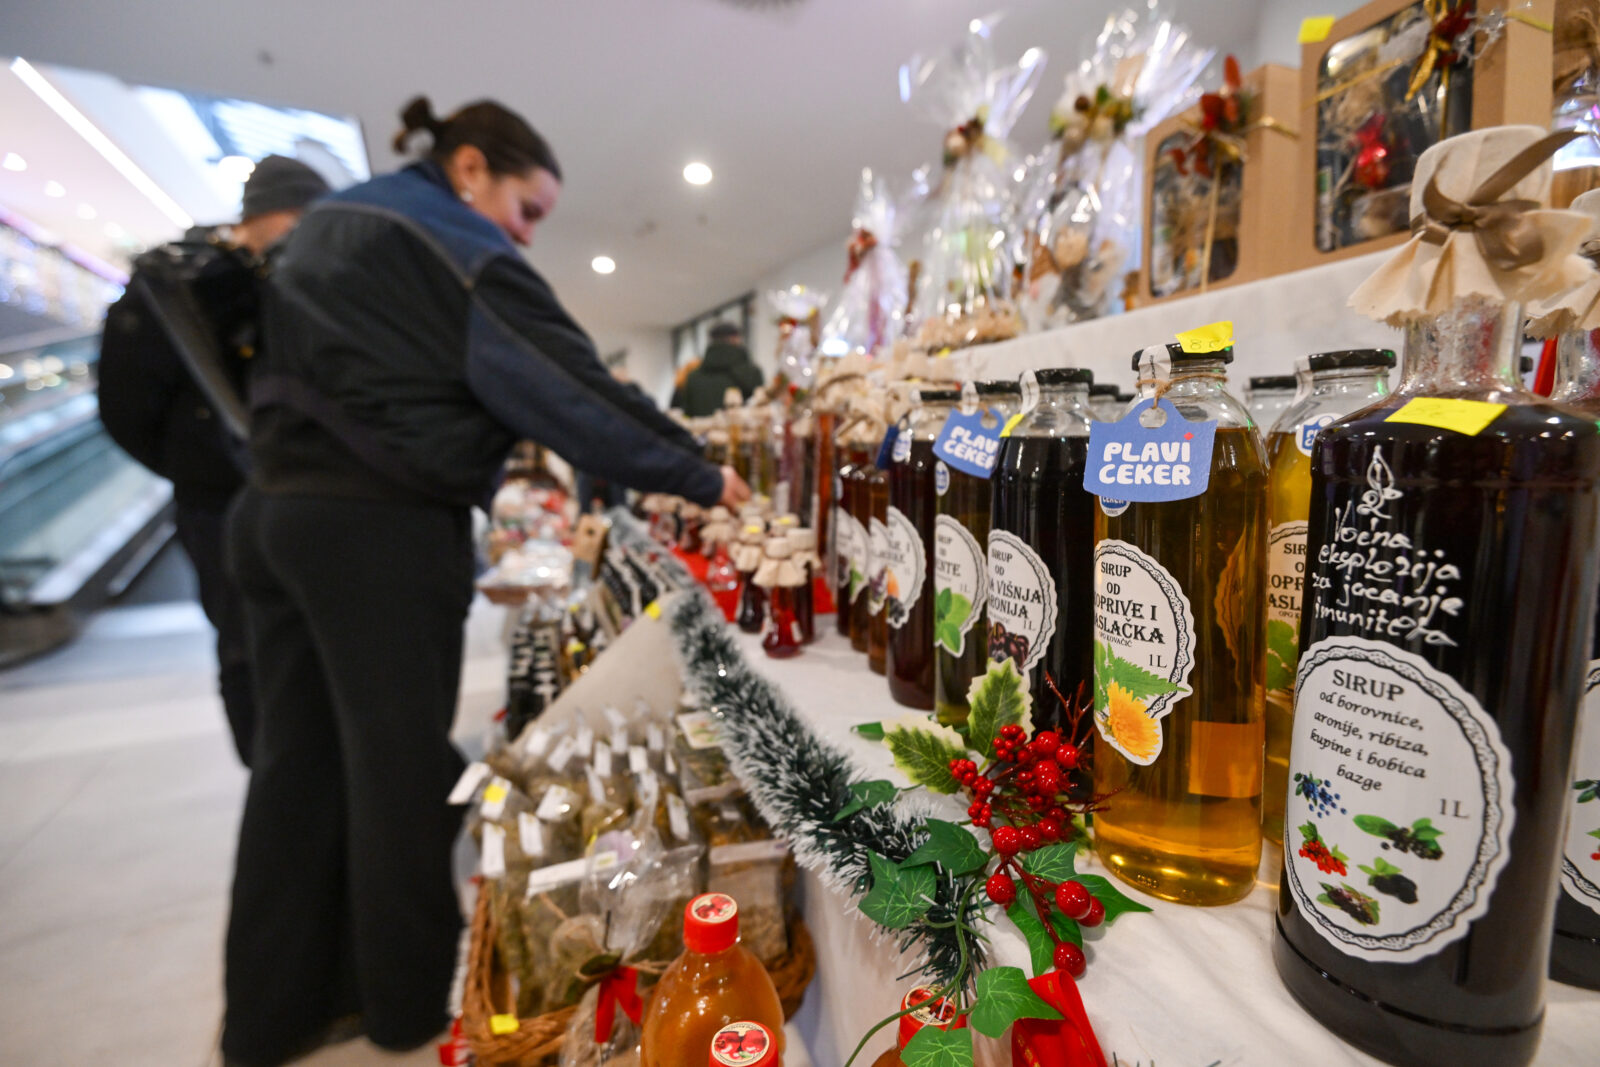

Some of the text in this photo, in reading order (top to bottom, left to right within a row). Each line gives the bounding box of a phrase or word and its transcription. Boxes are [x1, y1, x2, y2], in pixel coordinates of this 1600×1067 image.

[951, 425, 1000, 455] PLAV
[1103, 441, 1191, 463] PLAVI
[1099, 463, 1191, 486] CEKER
[1284, 543, 1307, 556] SIR
[995, 565, 1004, 576] OD
[1100, 561, 1131, 578] SIRUP
[1312, 572, 1331, 588] za
[997, 580, 1042, 604] VIŠNJA
[1106, 581, 1120, 595] OD
[989, 594, 1028, 619] RONIJA
[1094, 592, 1145, 620] OPRIVE
[1094, 612, 1165, 644] ASLAČKA
[1333, 669, 1404, 701] SIRUP
[1320, 692, 1424, 730] od borovnice,
[1314, 712, 1428, 756] aronije, ribiza,
[1310, 729, 1427, 778] kupine i bobica
[1337, 764, 1382, 791] bazge
